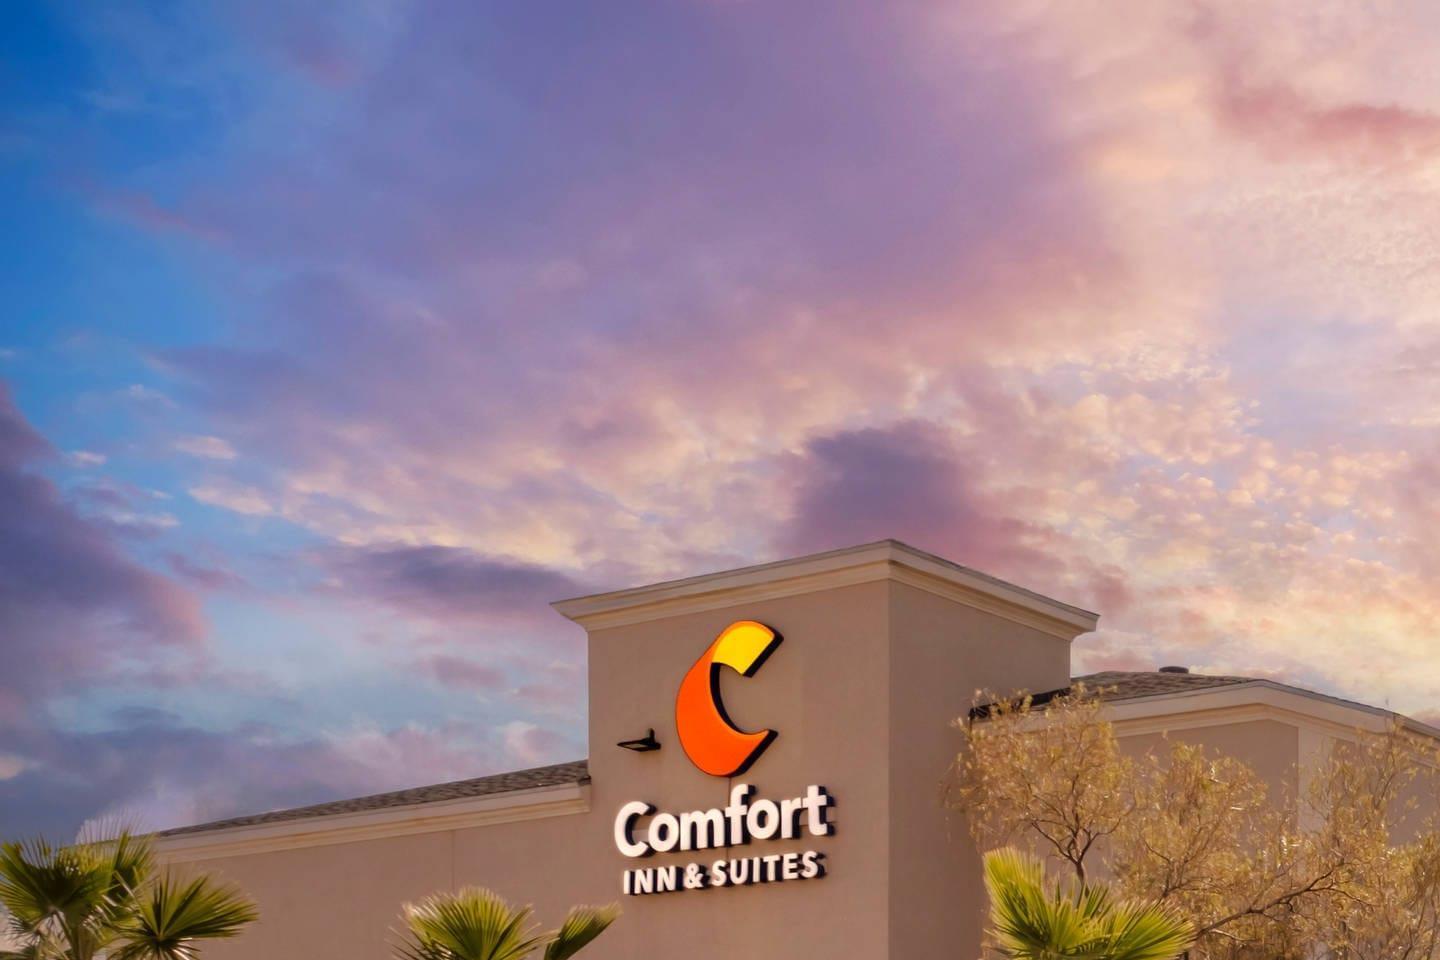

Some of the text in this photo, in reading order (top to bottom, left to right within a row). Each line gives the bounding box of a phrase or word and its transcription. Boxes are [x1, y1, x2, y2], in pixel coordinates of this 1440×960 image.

[614, 784, 829, 857] Comfort
[623, 851, 819, 894] INN & SUITES
